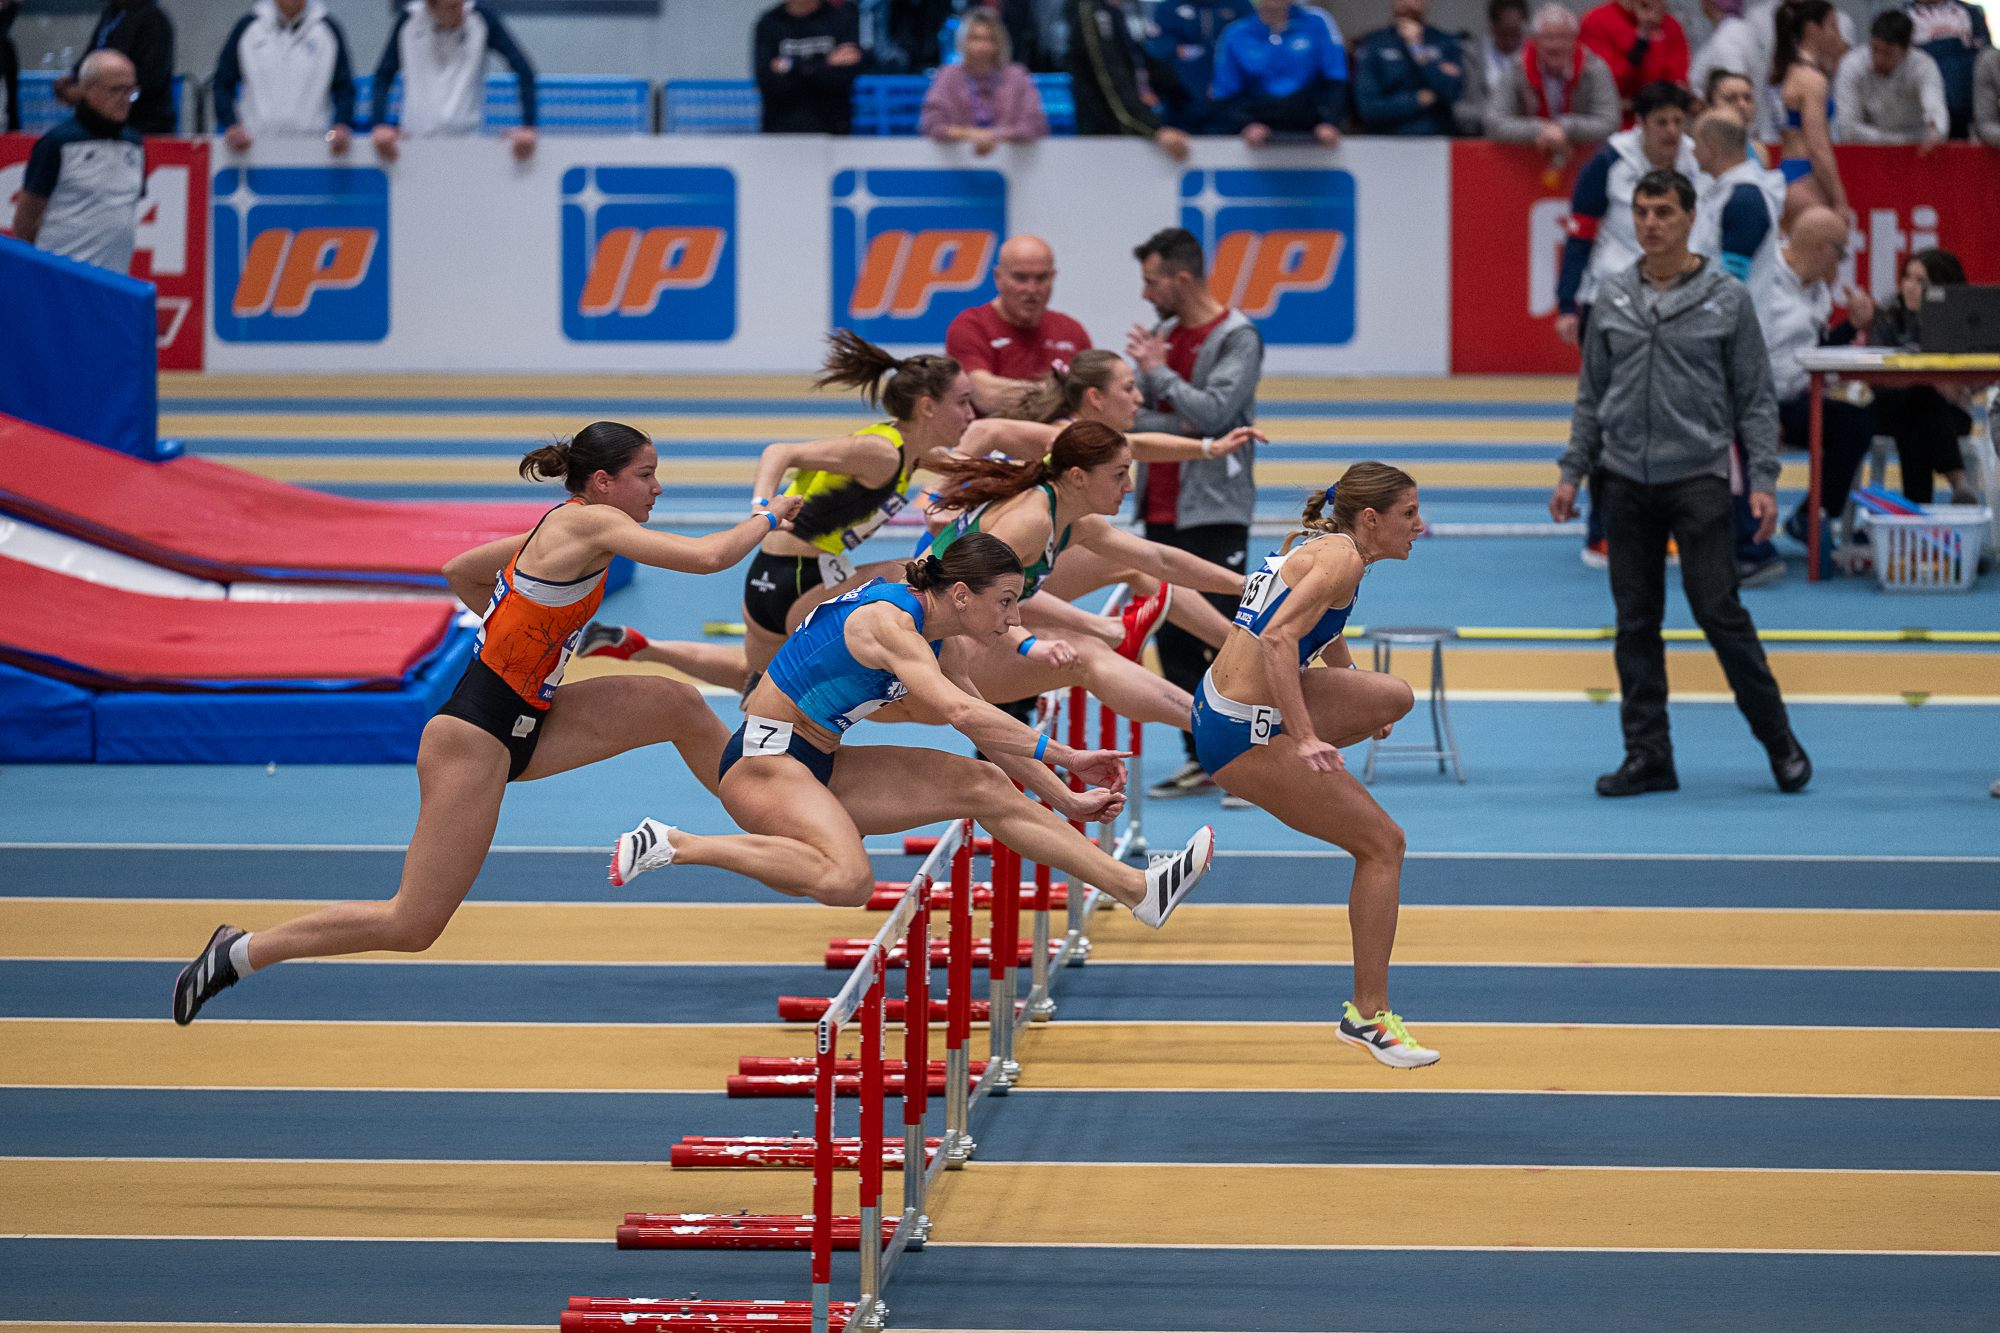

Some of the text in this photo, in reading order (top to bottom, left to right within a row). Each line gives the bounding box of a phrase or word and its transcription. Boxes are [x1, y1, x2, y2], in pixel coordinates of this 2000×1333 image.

[231, 227, 379, 318] IP
[578, 226, 727, 318] IP
[848, 229, 997, 319] IP
[1207, 229, 1345, 319] IP
[828, 558, 847, 584] 3
[759, 724, 778, 749] 7
[1254, 708, 1271, 738] 5
